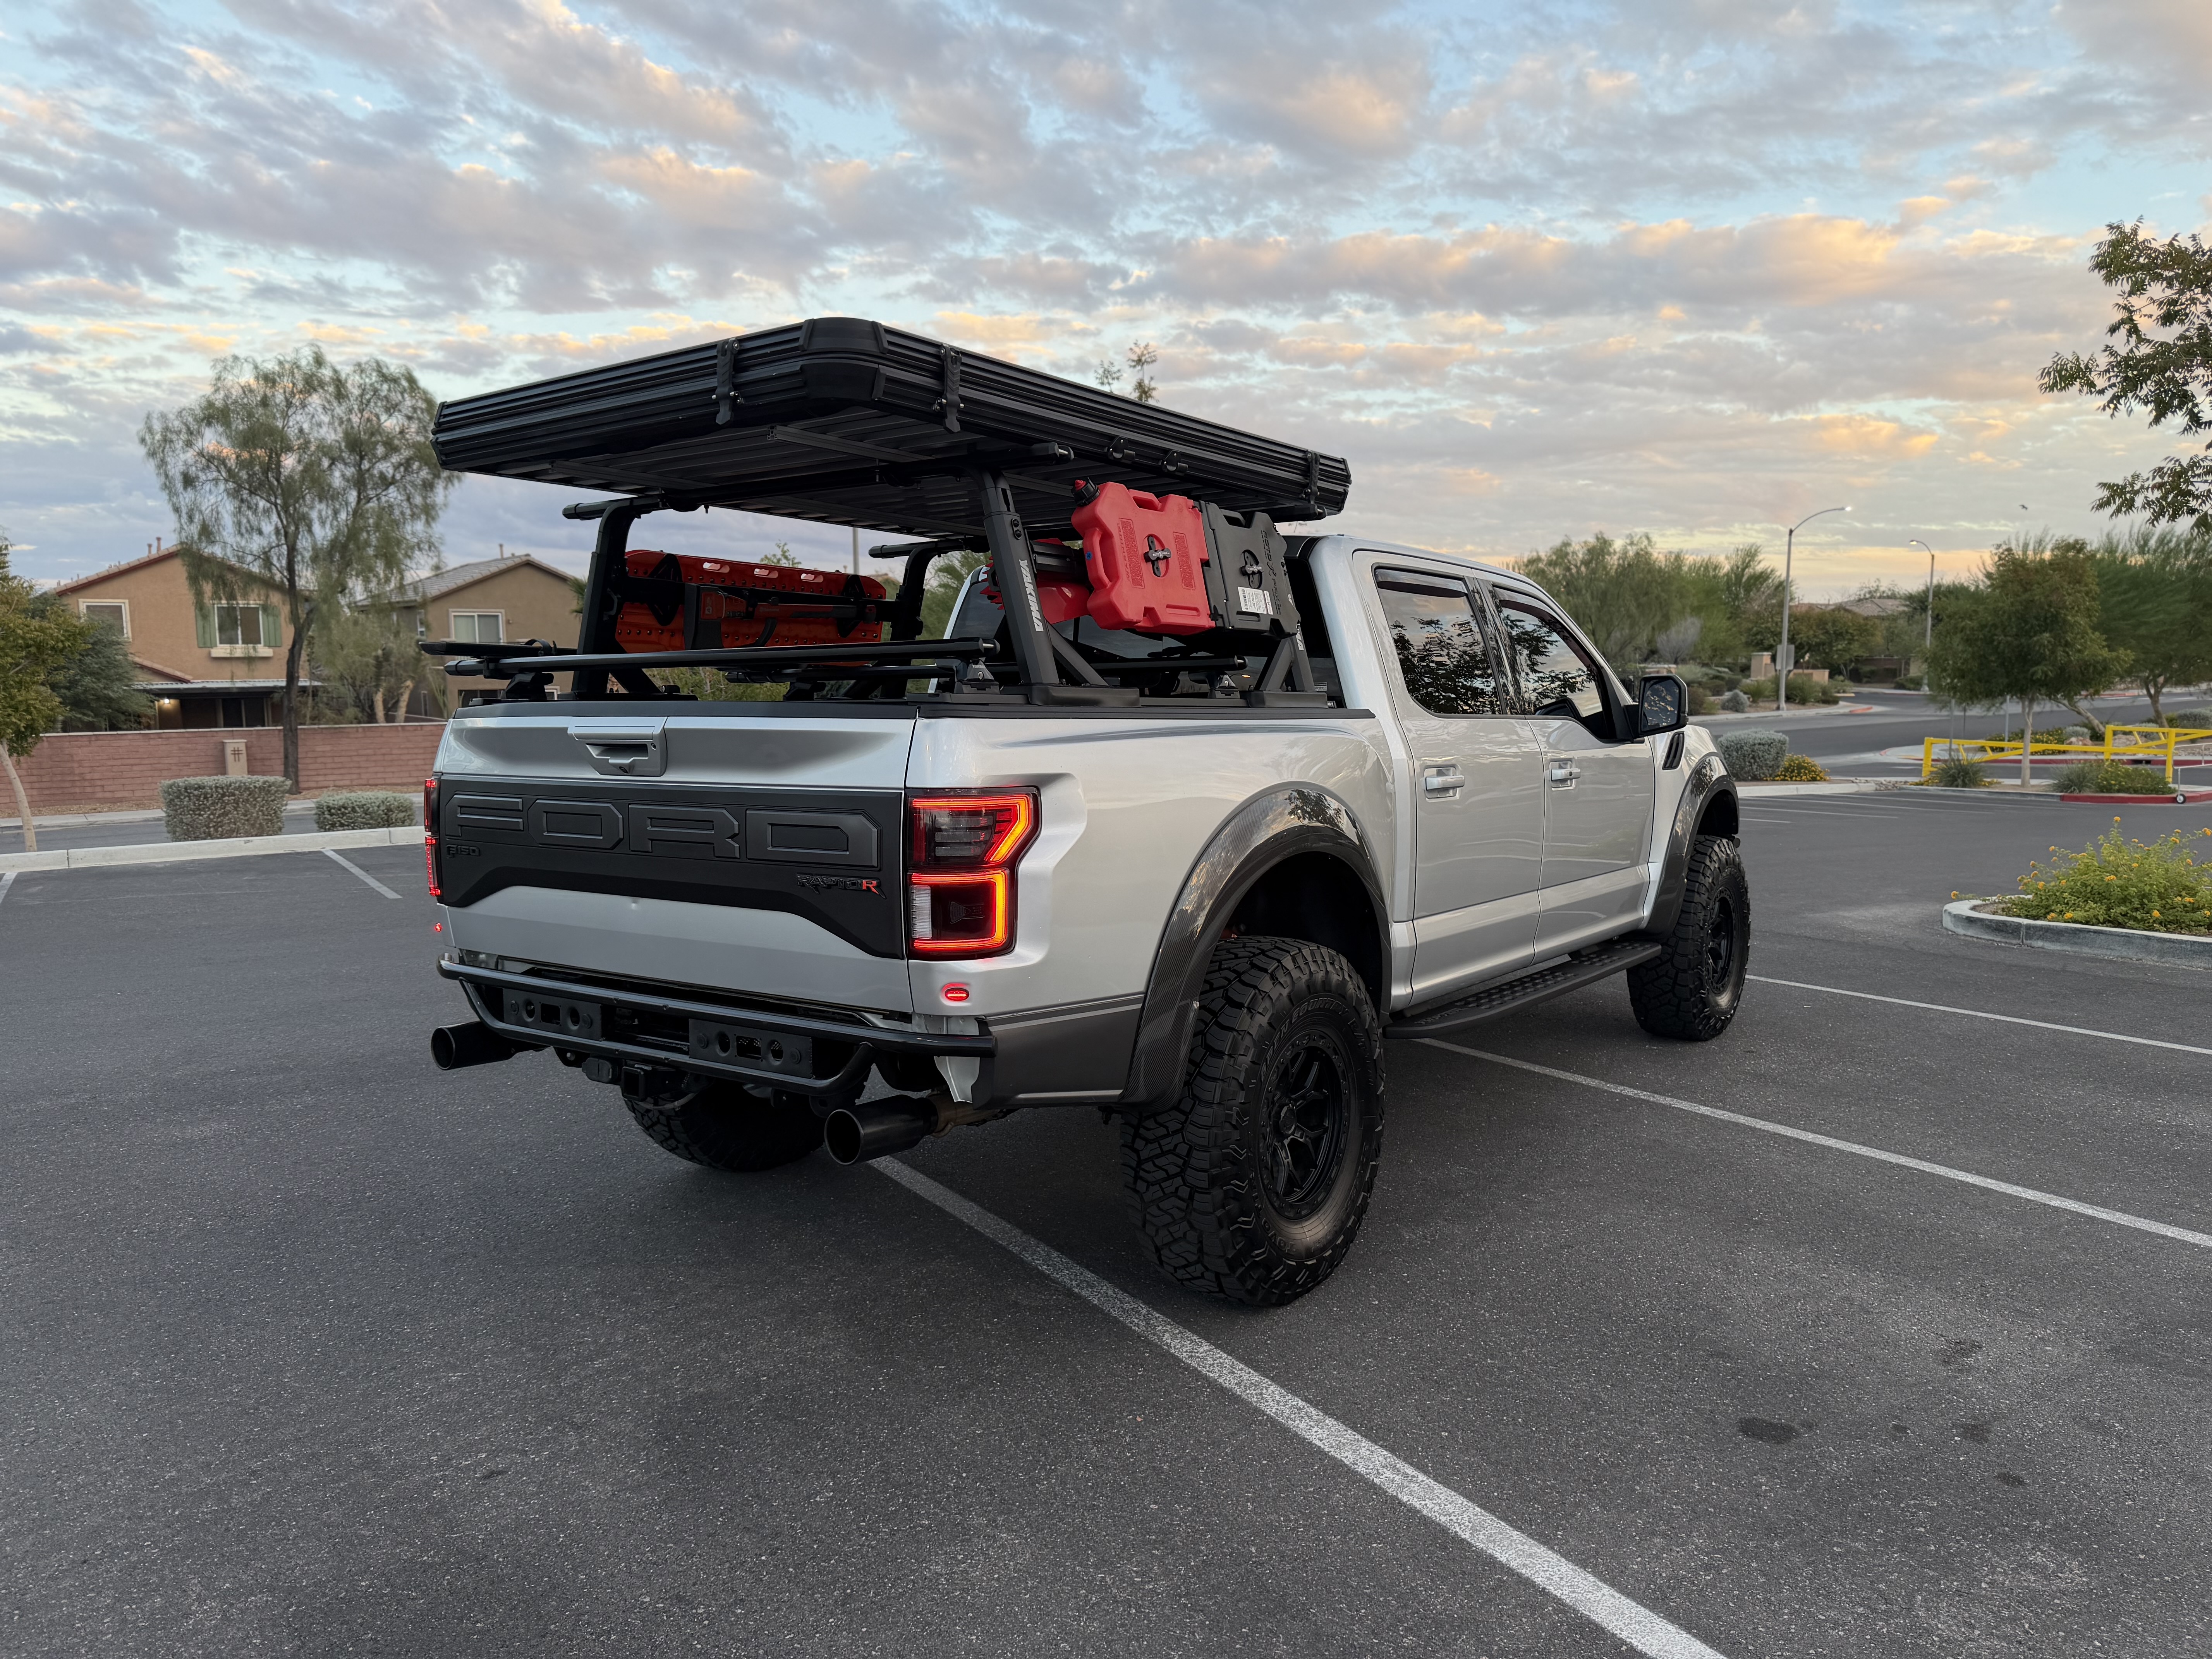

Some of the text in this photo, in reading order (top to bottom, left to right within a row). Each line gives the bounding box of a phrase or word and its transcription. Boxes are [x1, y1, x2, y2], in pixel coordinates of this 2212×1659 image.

[1019, 559, 1044, 632] YAKIMA
[445, 794, 878, 867] FORD
[796, 873, 887, 899] RAPTOR
[1260, 1019, 1290, 1083] OPEN
[1291, 997, 1350, 1024] COUNTRY
